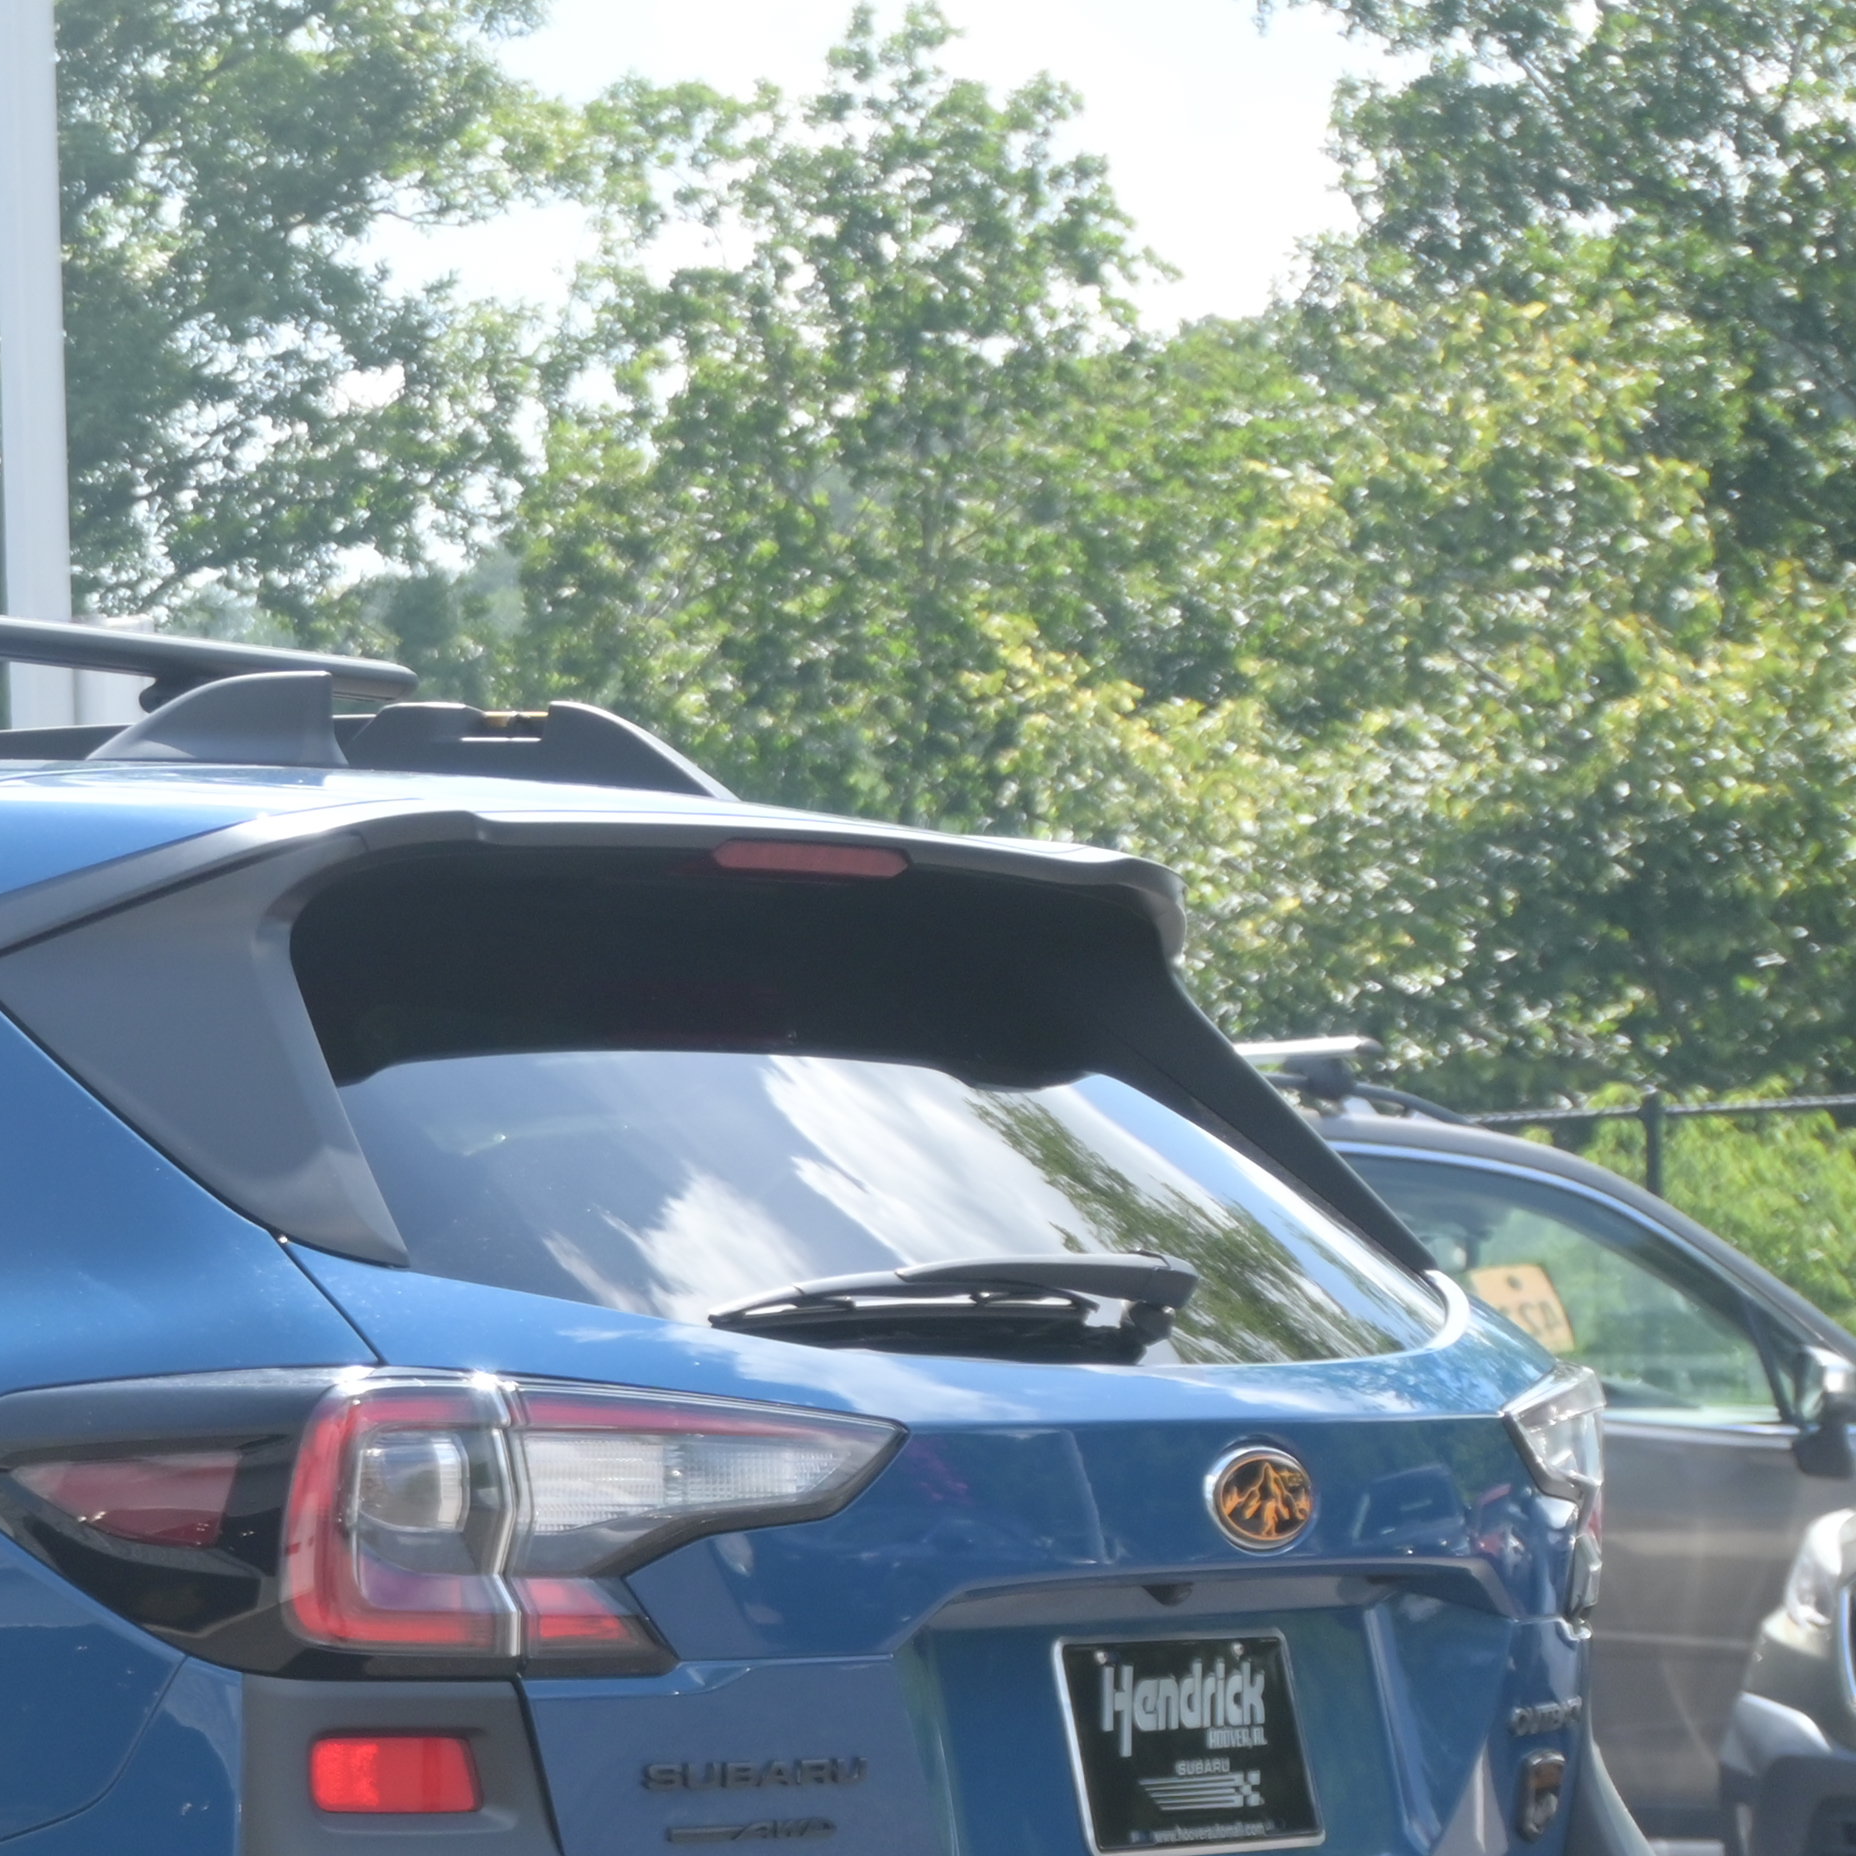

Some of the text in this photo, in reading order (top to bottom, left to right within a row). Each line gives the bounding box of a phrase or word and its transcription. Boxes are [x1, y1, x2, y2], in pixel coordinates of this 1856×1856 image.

[1101, 1657, 1267, 1758] Hendrick
[1509, 1697, 1582, 1736] OUTB
[642, 1757, 867, 1791] SUBARU
[1175, 1758, 1231, 1776] SUBARU
